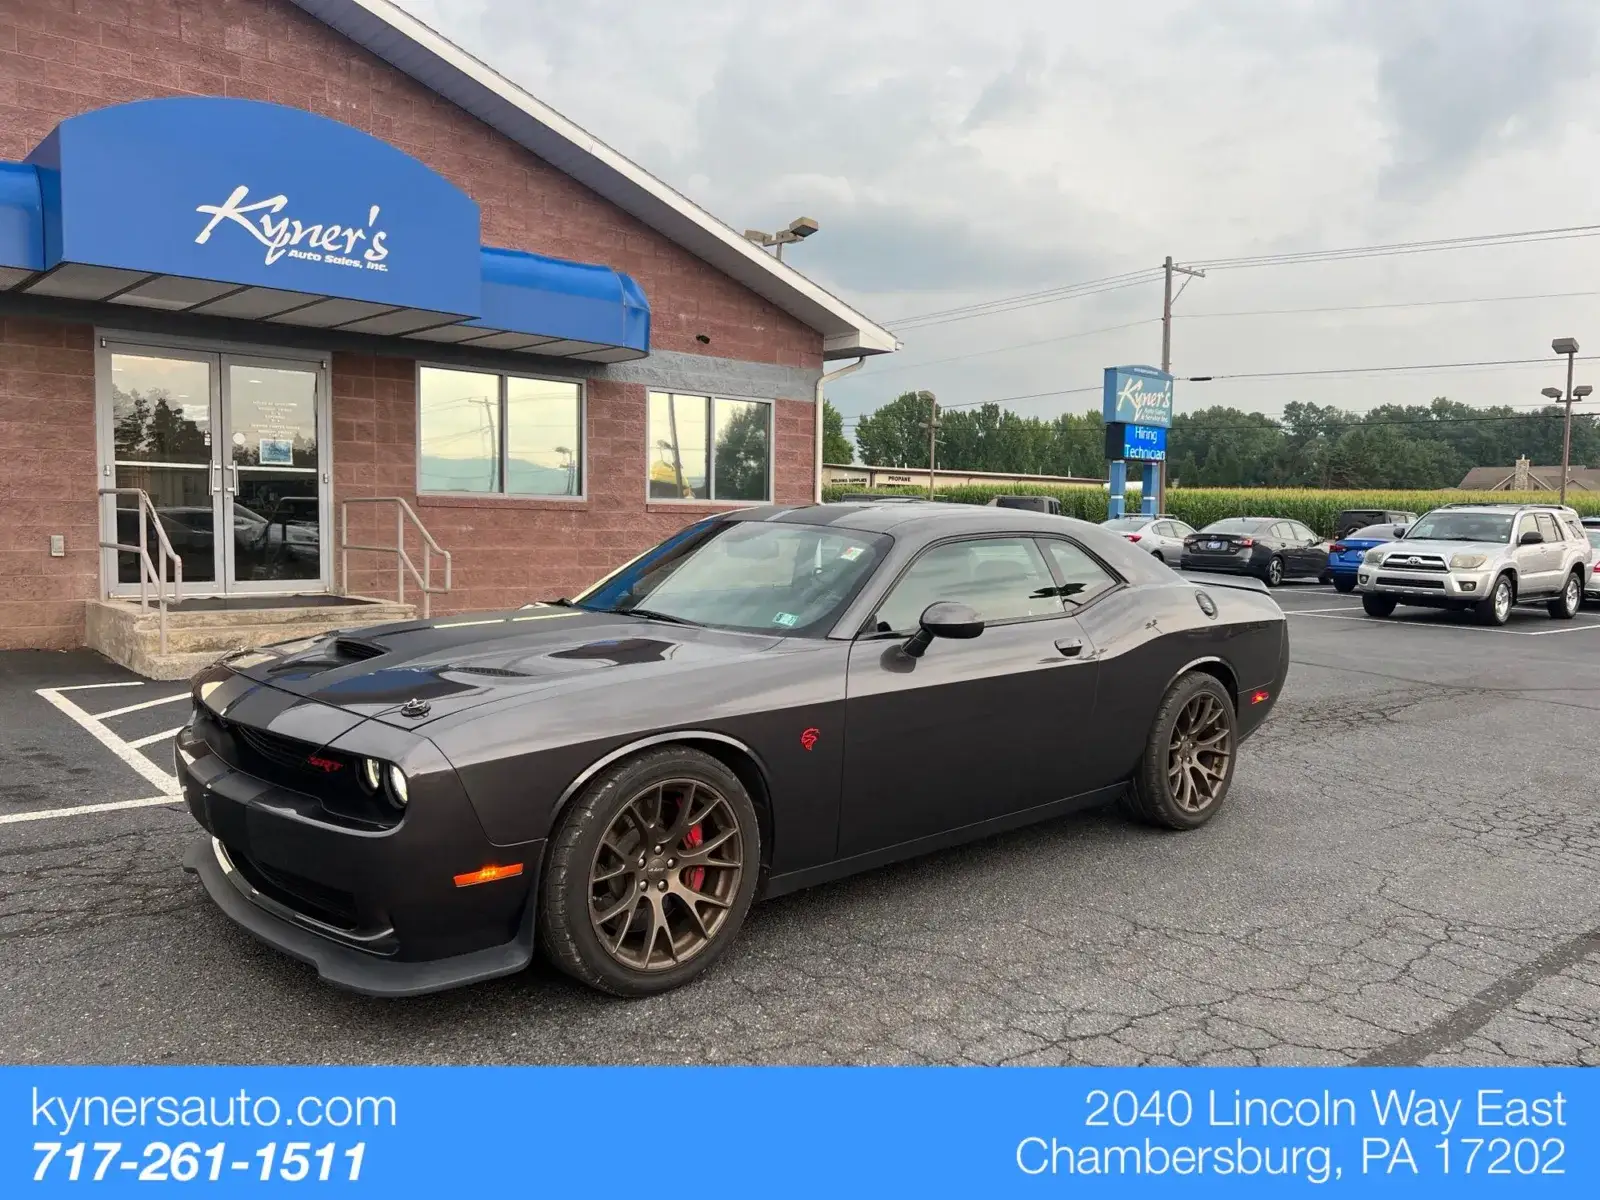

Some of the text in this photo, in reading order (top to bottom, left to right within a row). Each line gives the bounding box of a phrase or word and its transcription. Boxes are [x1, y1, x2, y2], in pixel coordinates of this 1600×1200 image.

[194, 185, 389, 266] Kyner's
[288, 250, 389, 272] Auto Sales, Inc.
[1117, 377, 1171, 422] Kyner's
[1135, 426, 1157, 444] Hiring
[1124, 444, 1165, 460] Technician
